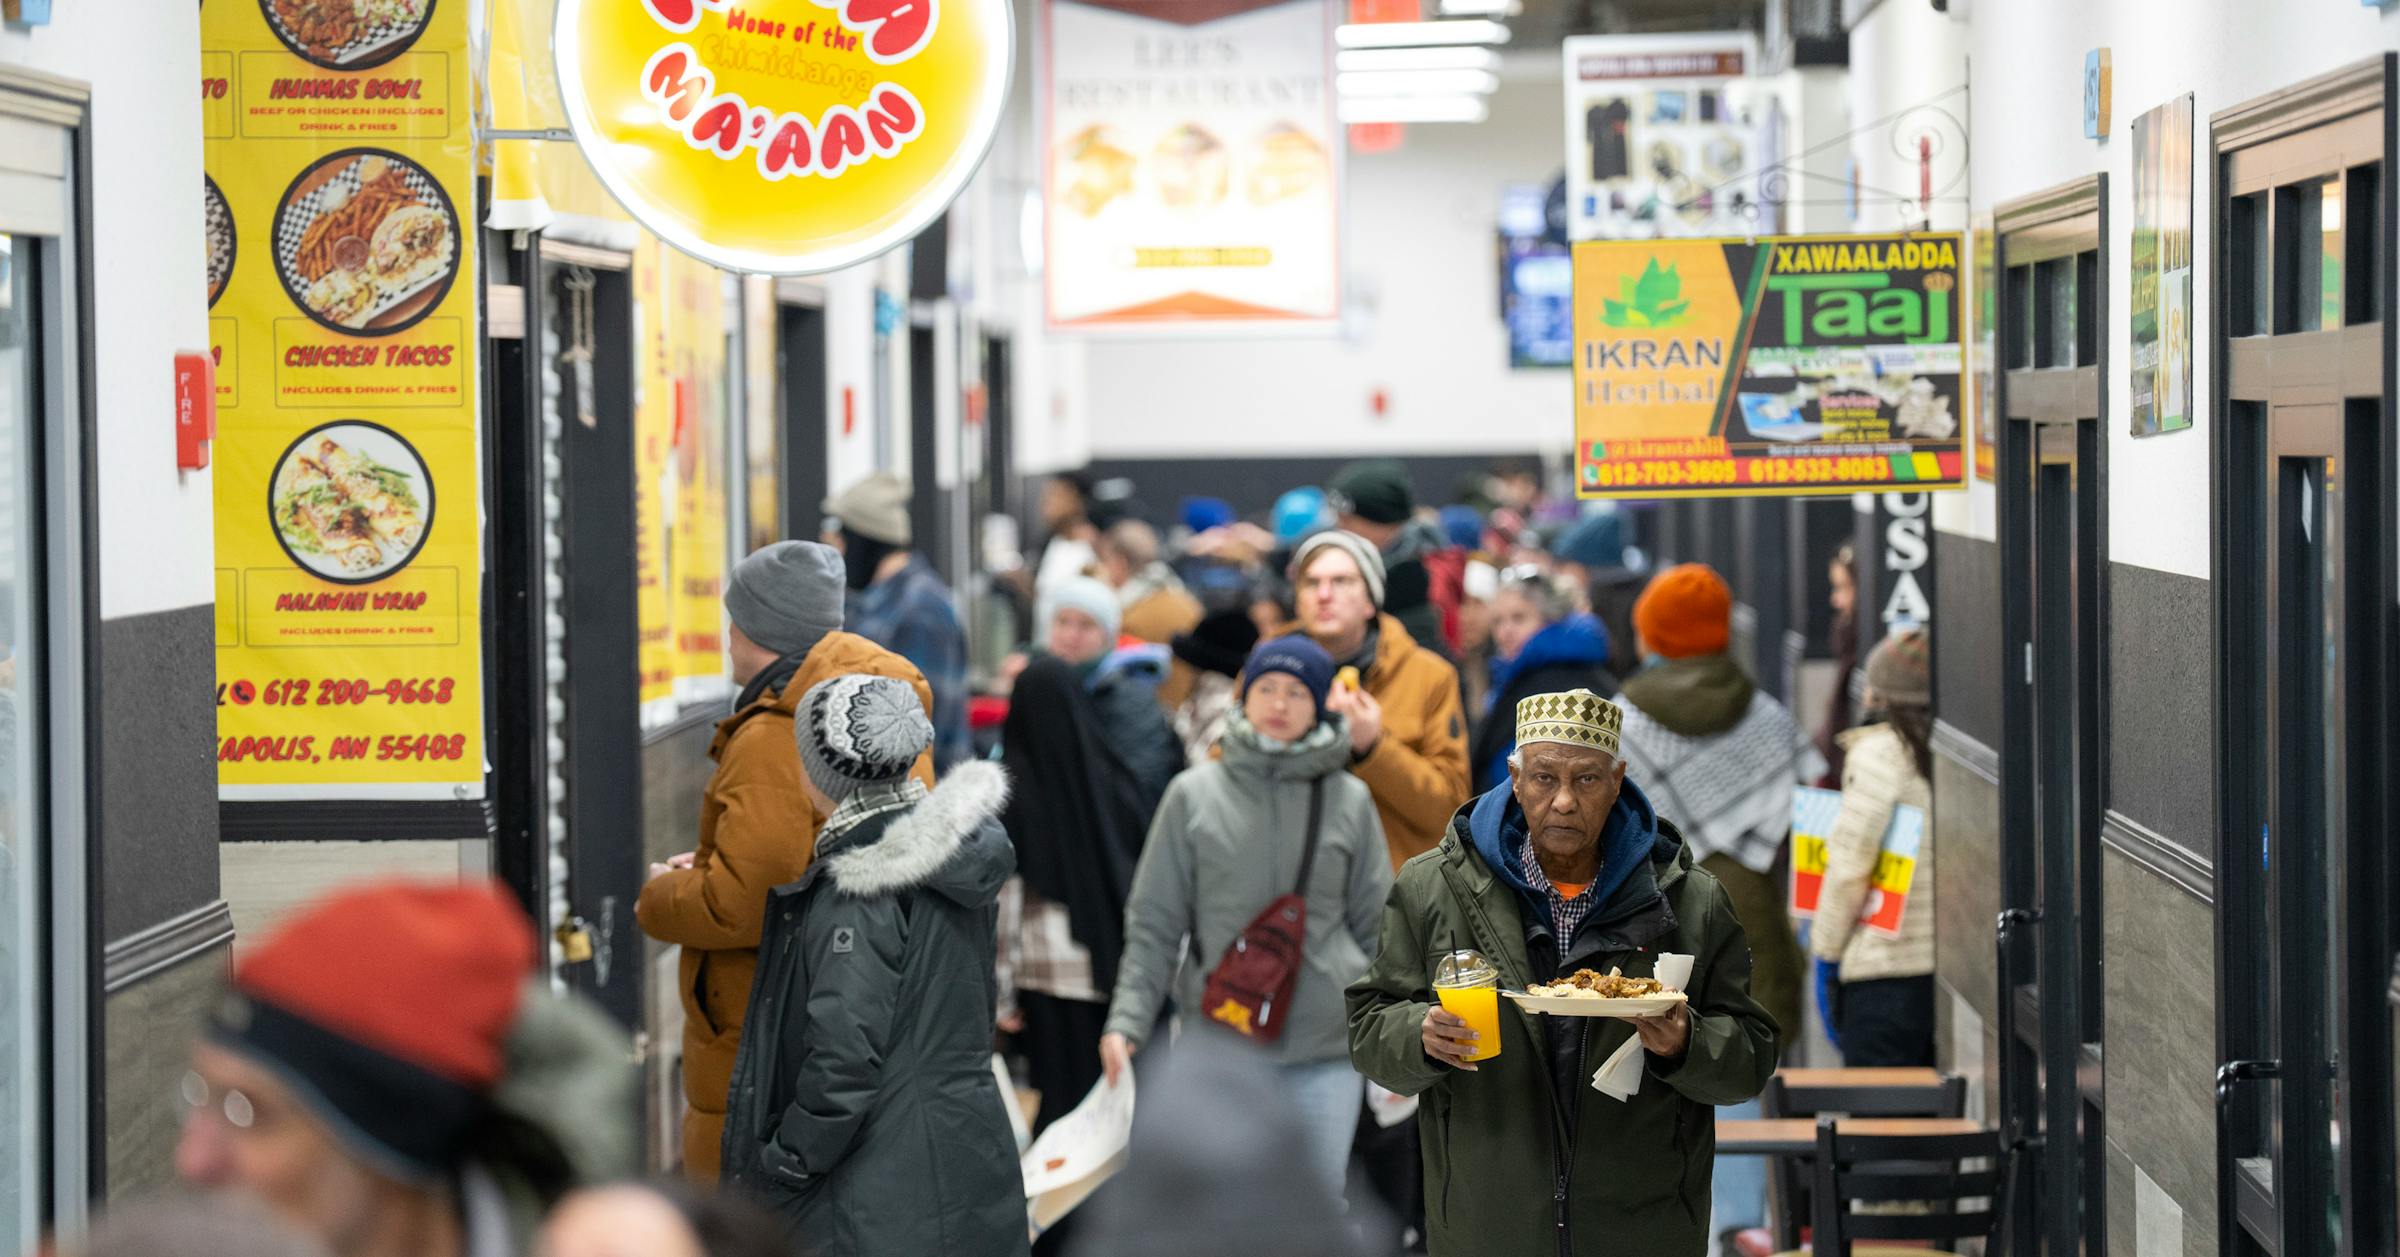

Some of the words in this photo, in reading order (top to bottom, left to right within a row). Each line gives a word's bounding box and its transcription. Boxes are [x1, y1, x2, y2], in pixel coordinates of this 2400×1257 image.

[727, 9, 787, 40] Home
[794, 22, 817, 43] of
[823, 25, 858, 53] the
[270, 78, 360, 100] HUMMAS
[364, 78, 422, 99] BOWL
[249, 107, 284, 115] BEEF
[287, 107, 306, 115] OR
[308, 107, 370, 115] CHICKEN
[377, 107, 445, 115] INCLUDES
[648, 51, 917, 174] MA'AAN
[299, 122, 344, 131] DRINK
[347, 122, 358, 131] &
[359, 122, 398, 131] FRIES
[1776, 240, 1956, 274] XAWAALADDA
[284, 345, 379, 367] CHICKEN
[385, 345, 455, 367] TACOS
[1584, 337, 1723, 371] IKRAN
[179, 372, 192, 425] FIRE
[282, 385, 353, 394] INCLUDES
[354, 385, 400, 394] DRINK
[404, 385, 414, 394] &
[417, 385, 457, 394] FRIES
[1585, 375, 1715, 406] Herbal
[372, 591, 427, 610] WRAP
[280, 627, 341, 636] INCLUDES
[344, 627, 385, 635] DRINK
[399, 627, 434, 635] FRIES
[263, 680, 308, 706] 612
[316, 678, 455, 705] 200-9668
[217, 735, 320, 764] APOLIS,
[328, 735, 371, 761] MN
[376, 734, 467, 760] 55408
